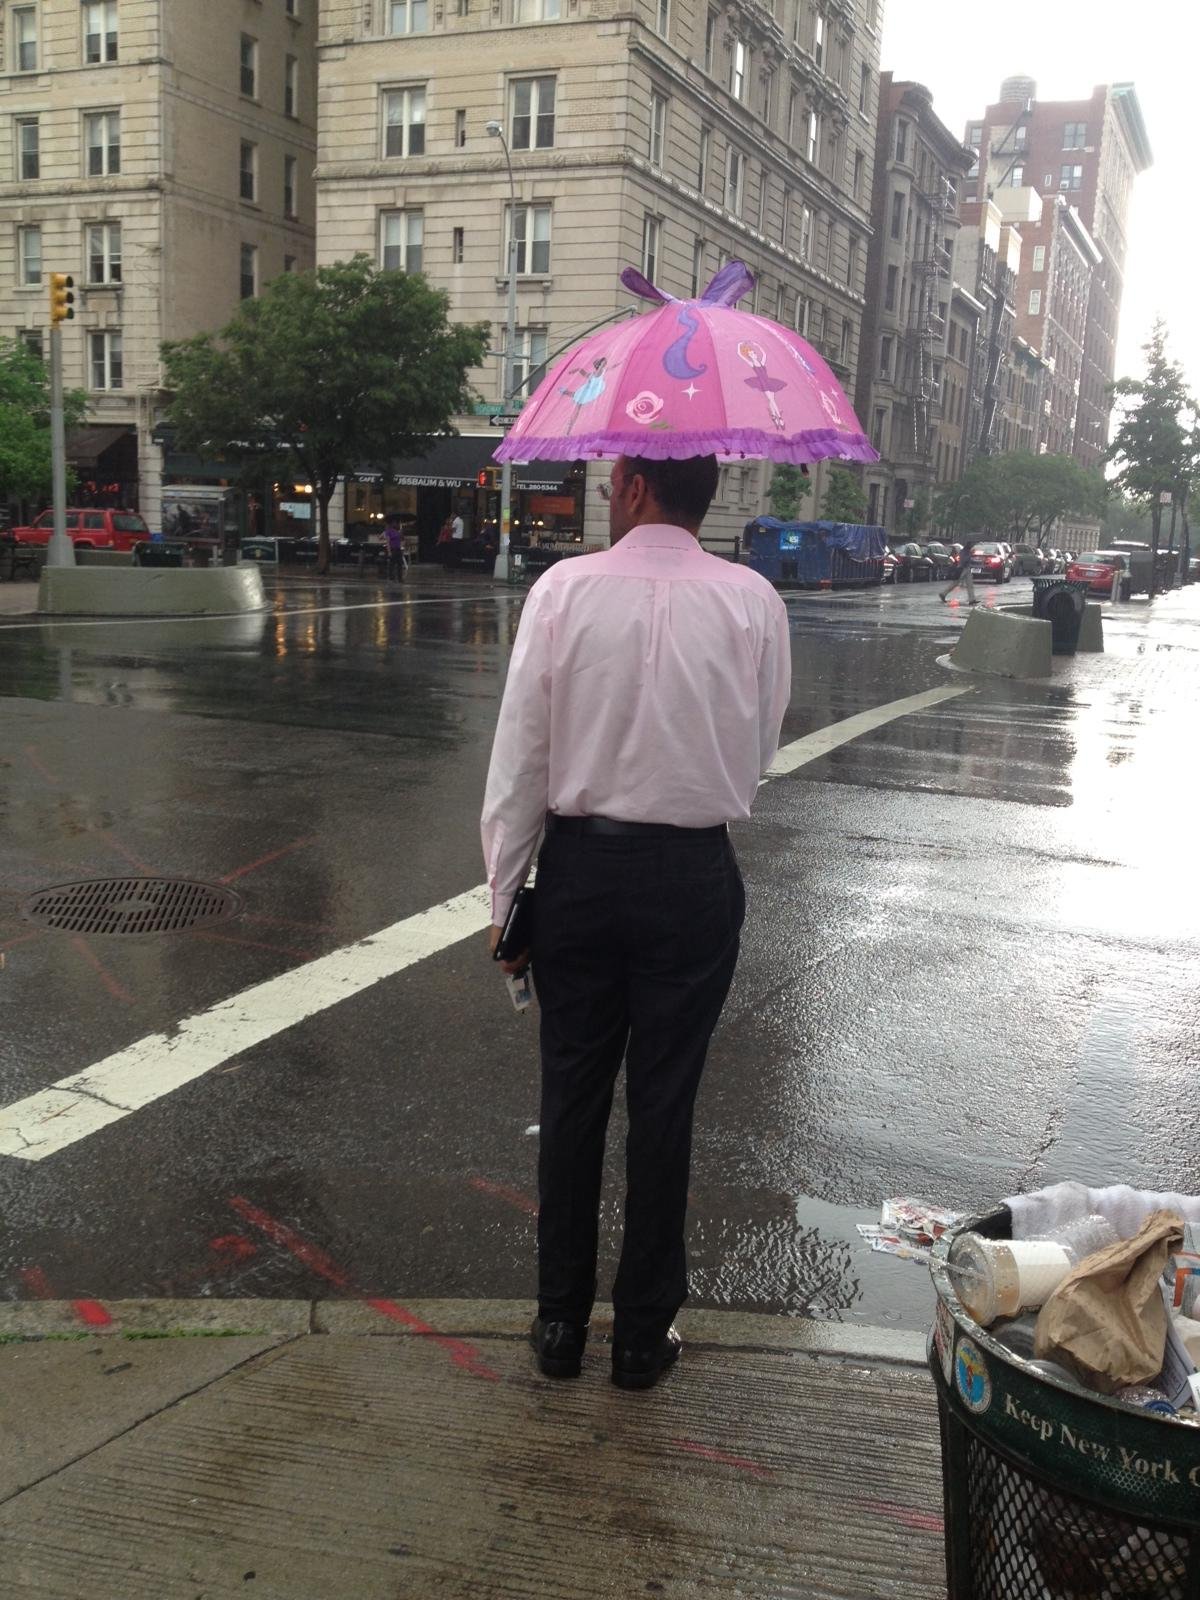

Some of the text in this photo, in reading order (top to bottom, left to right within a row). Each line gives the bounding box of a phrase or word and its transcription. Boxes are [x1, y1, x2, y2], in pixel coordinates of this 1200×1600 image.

[1005, 1393, 1053, 1441] Keep
[1060, 1423, 1111, 1462] New
[1117, 1446, 1181, 1485] York
